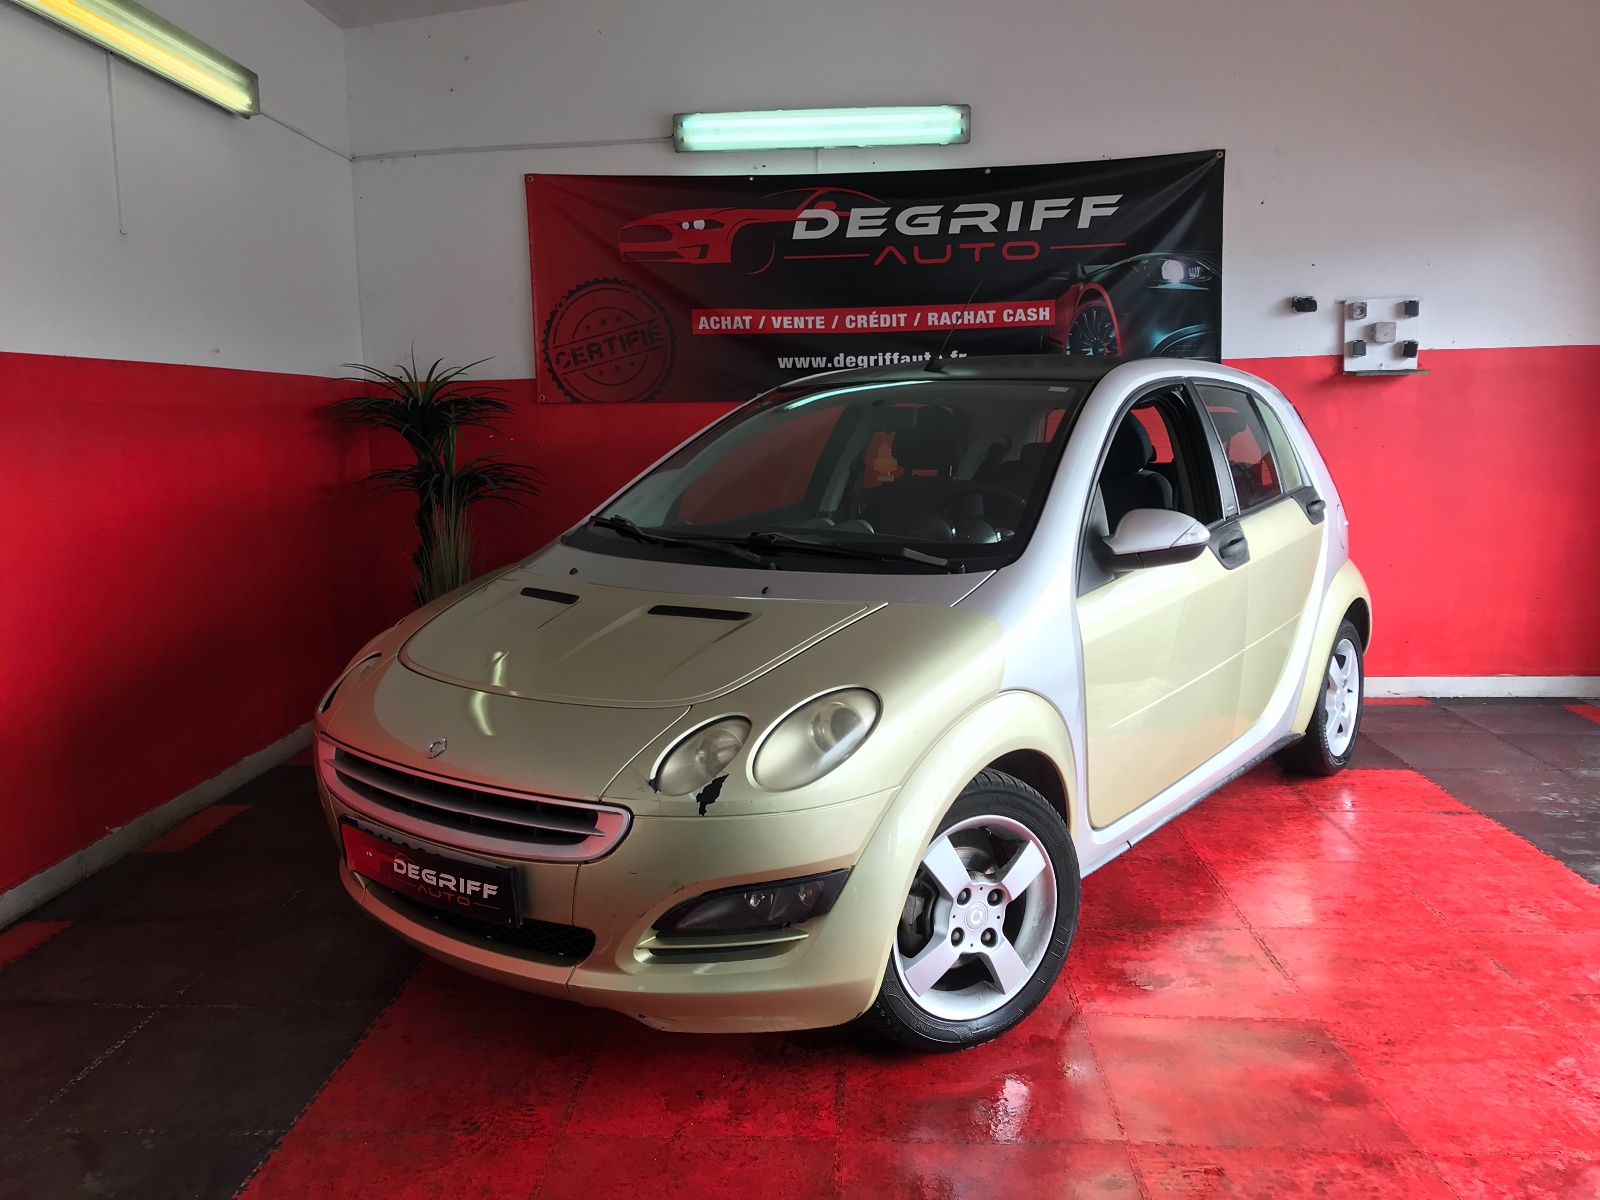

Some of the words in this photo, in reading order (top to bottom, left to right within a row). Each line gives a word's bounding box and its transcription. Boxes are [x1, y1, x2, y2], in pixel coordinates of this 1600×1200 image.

[792, 194, 1124, 240] DEGRIFF
[873, 240, 1040, 266] AUTO
[698, 315, 753, 330] ACHAT
[758, 315, 766, 329] /
[771, 316, 825, 329] VENTE
[831, 315, 839, 329] /
[845, 310, 907, 329] CRÉDIT
[913, 312, 921, 327] /
[927, 309, 996, 326] RACHAT
[1002, 306, 1050, 323] CASH
[393, 858, 499, 899] DEGRIFF
[417, 884, 471, 907] AUTO
